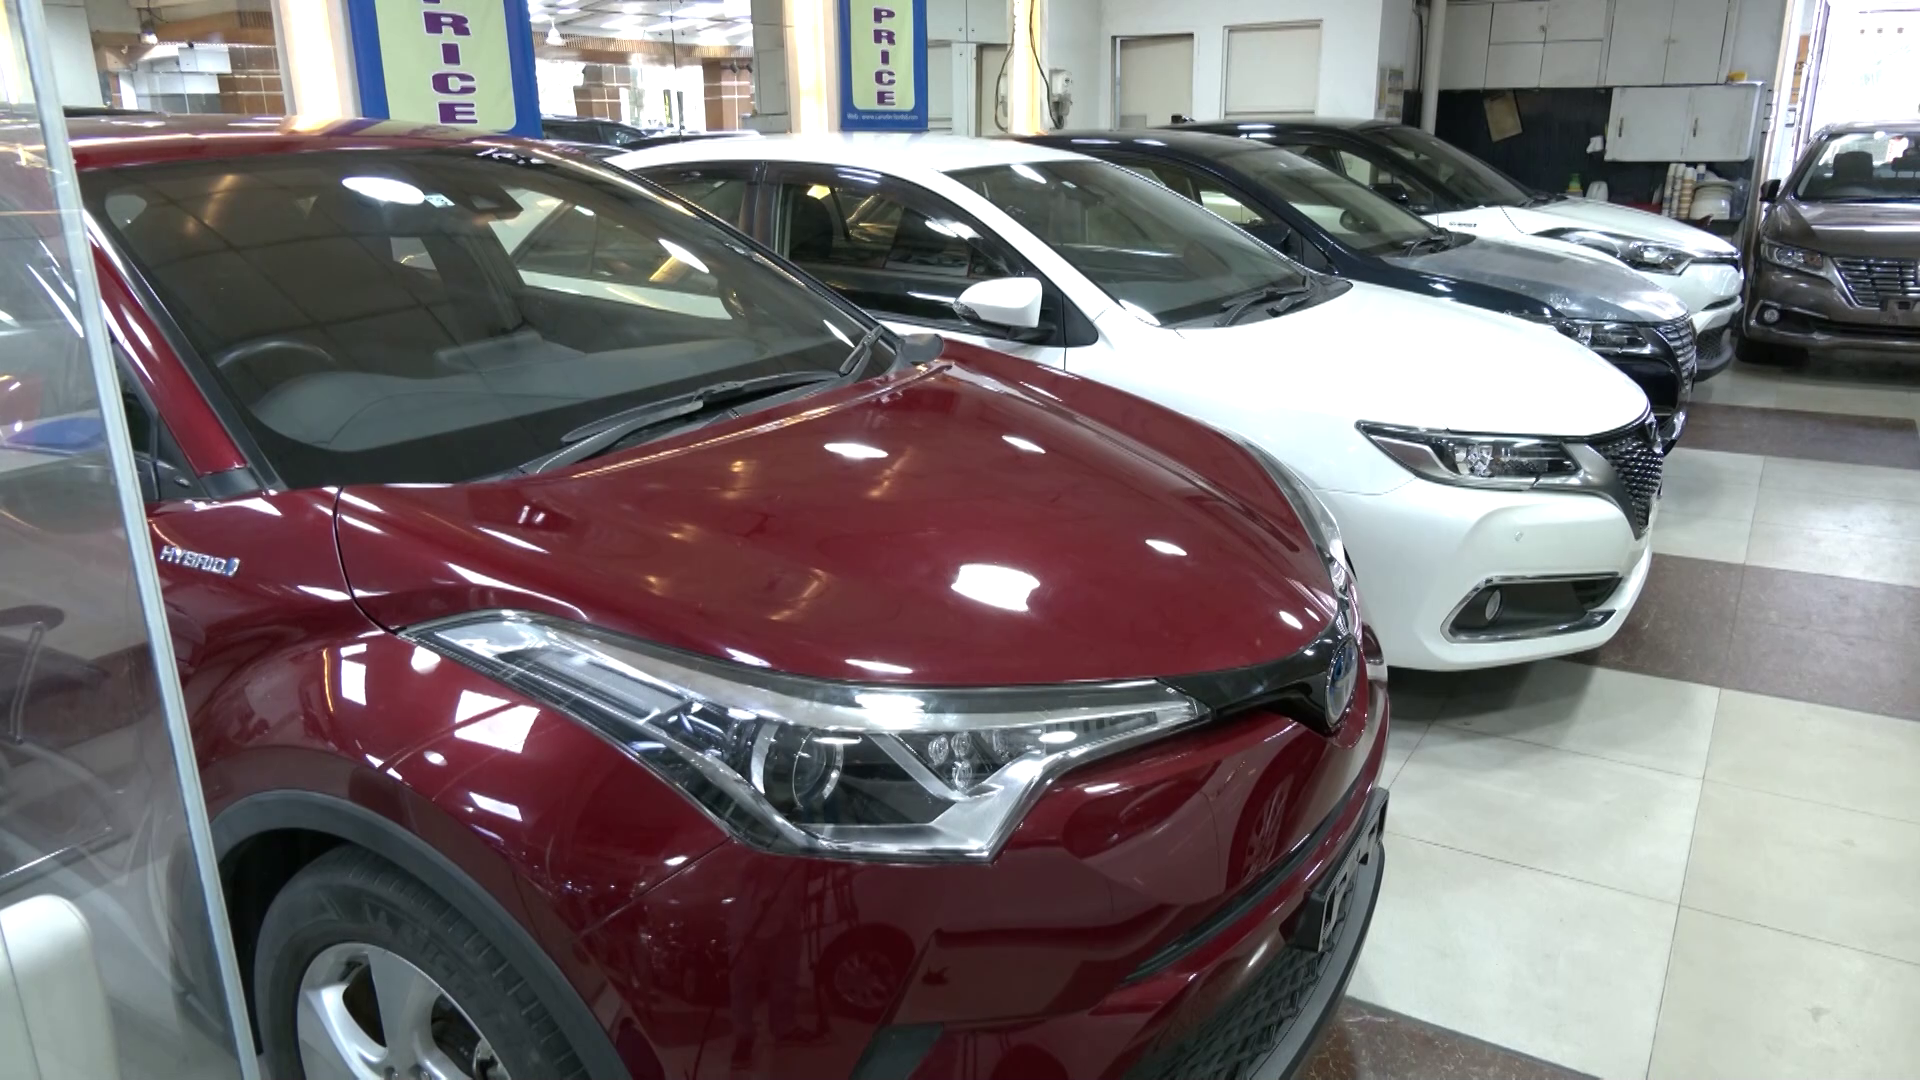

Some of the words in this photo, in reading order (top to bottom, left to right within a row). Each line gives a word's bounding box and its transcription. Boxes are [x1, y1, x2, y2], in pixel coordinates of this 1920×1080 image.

[423, 0, 478, 124] RICE
[873, 7, 896, 106] PRICE
[160, 545, 227, 574] HYBRID
